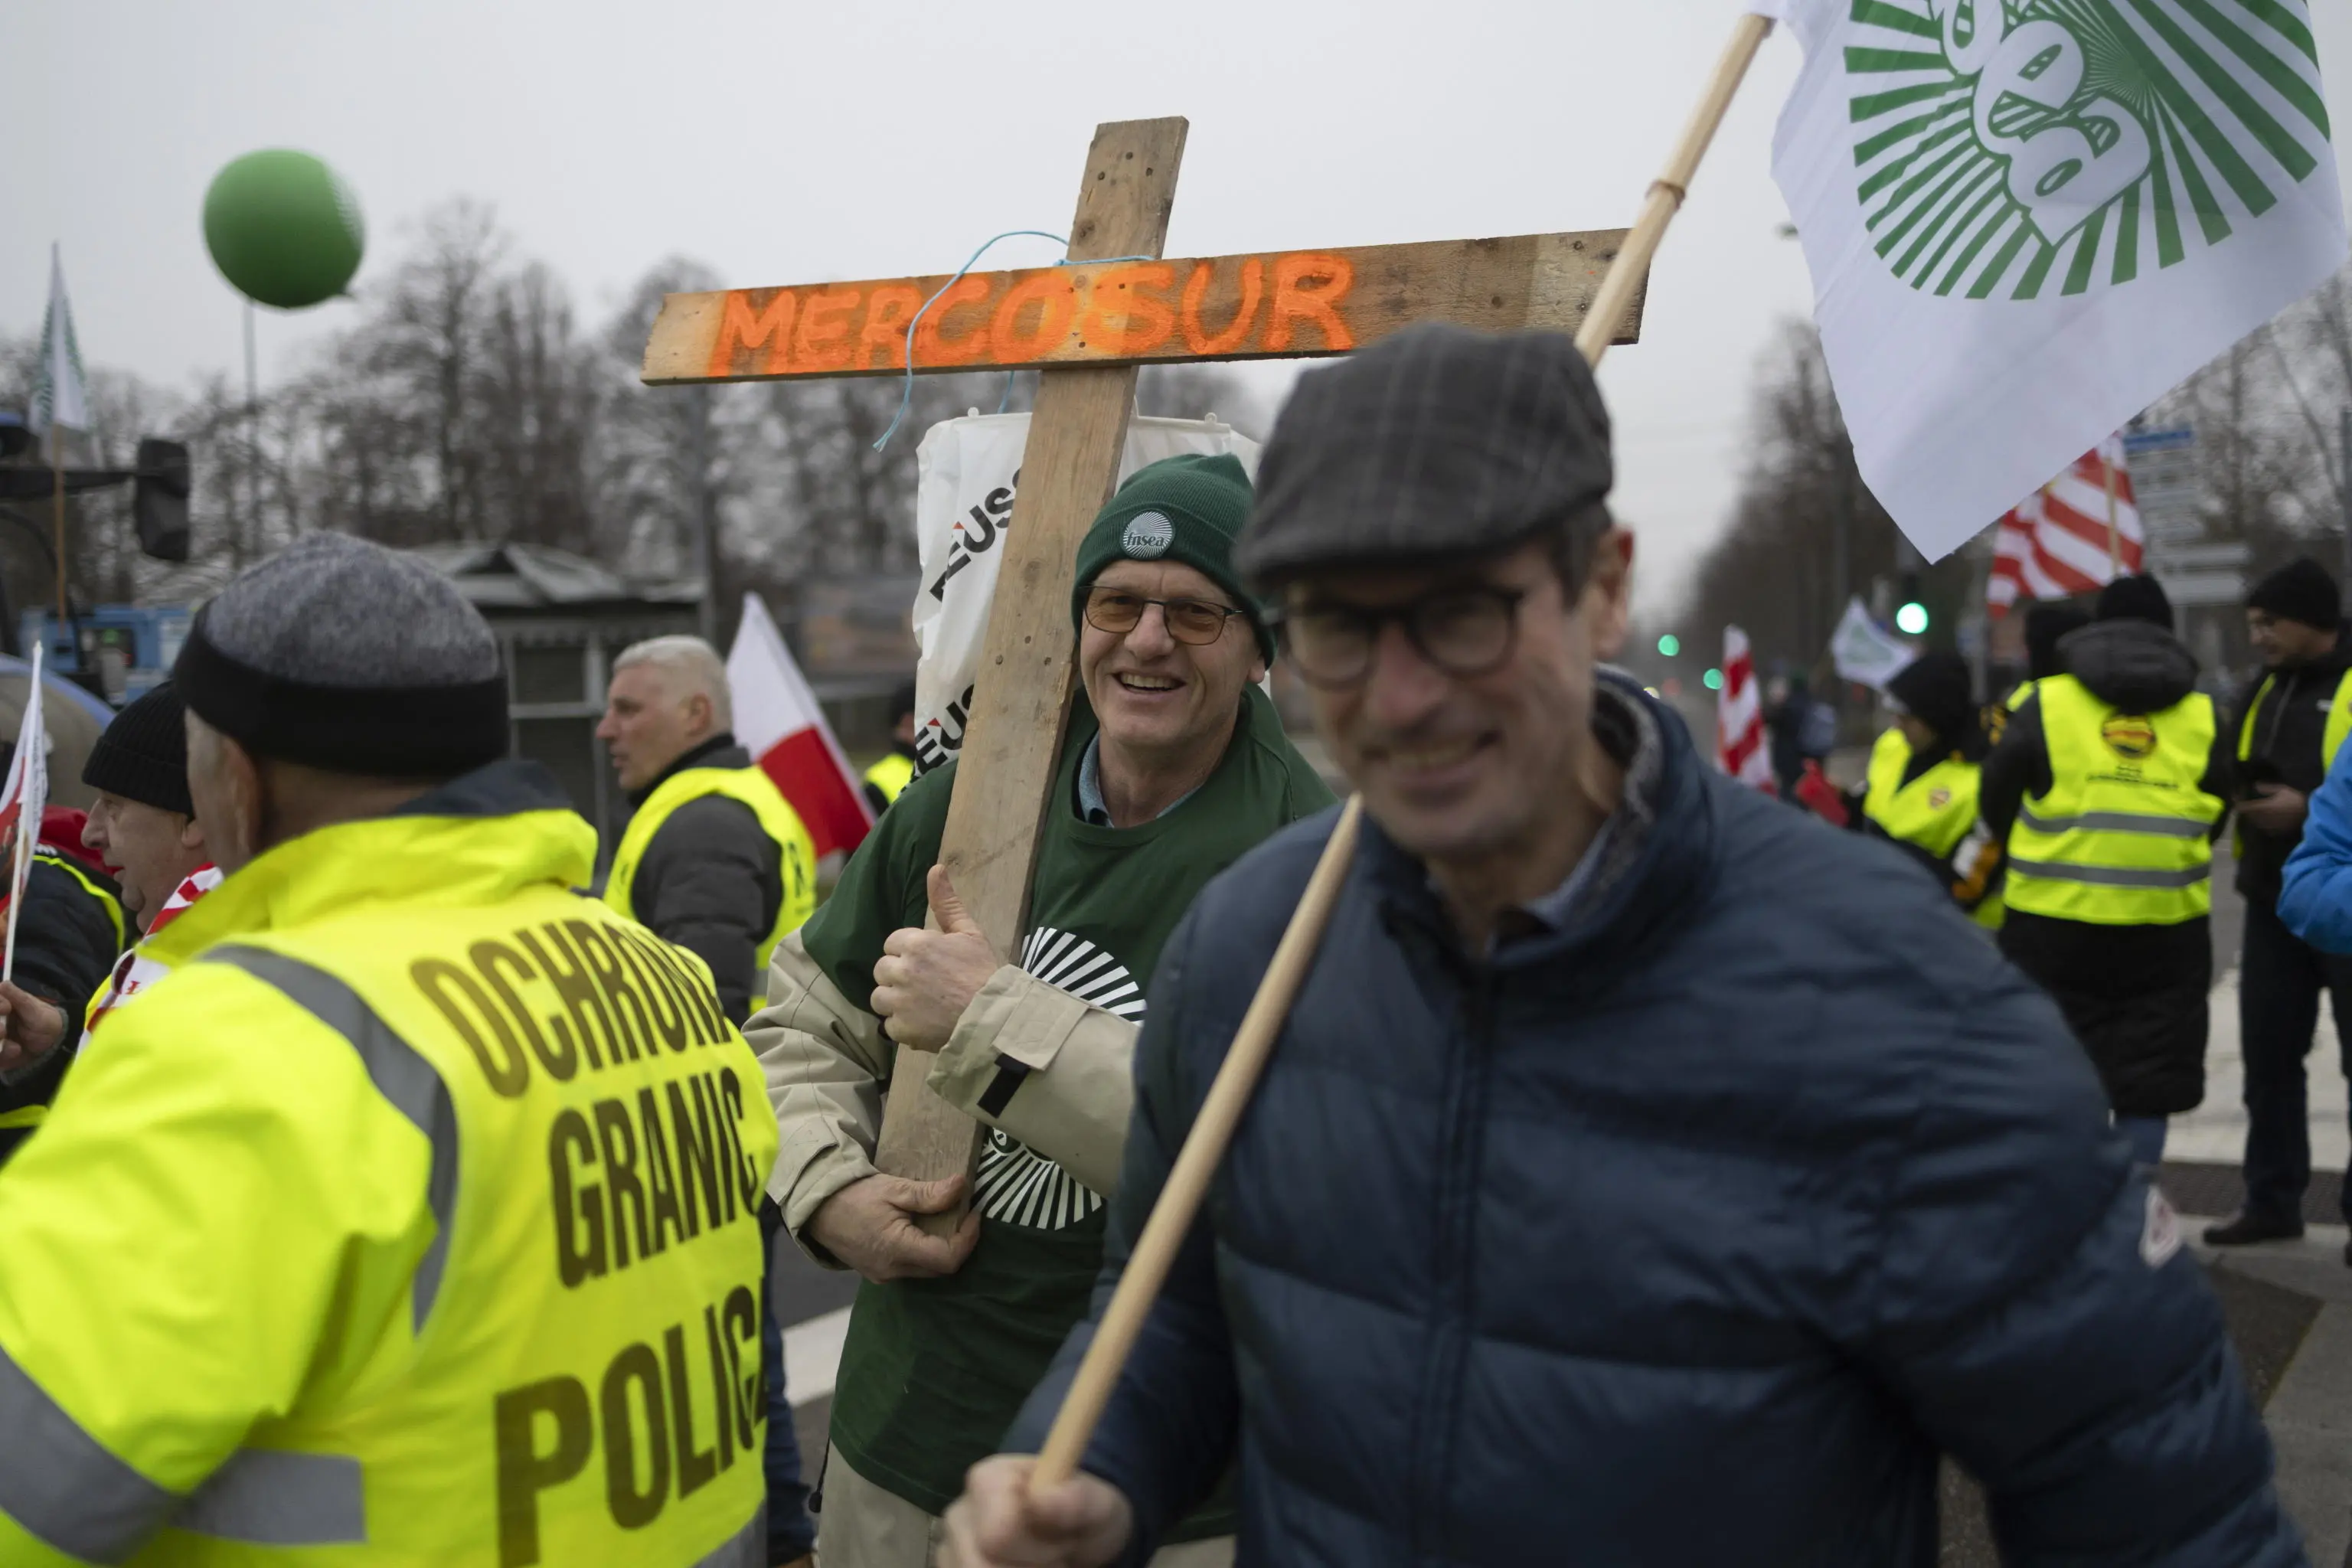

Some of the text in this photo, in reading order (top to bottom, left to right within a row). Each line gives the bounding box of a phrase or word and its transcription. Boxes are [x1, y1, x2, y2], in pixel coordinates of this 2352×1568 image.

[708, 252, 1355, 377] MERCOSUR
[1126, 531, 1165, 547] fnsea
[549, 1067, 759, 1290] GRANIC
